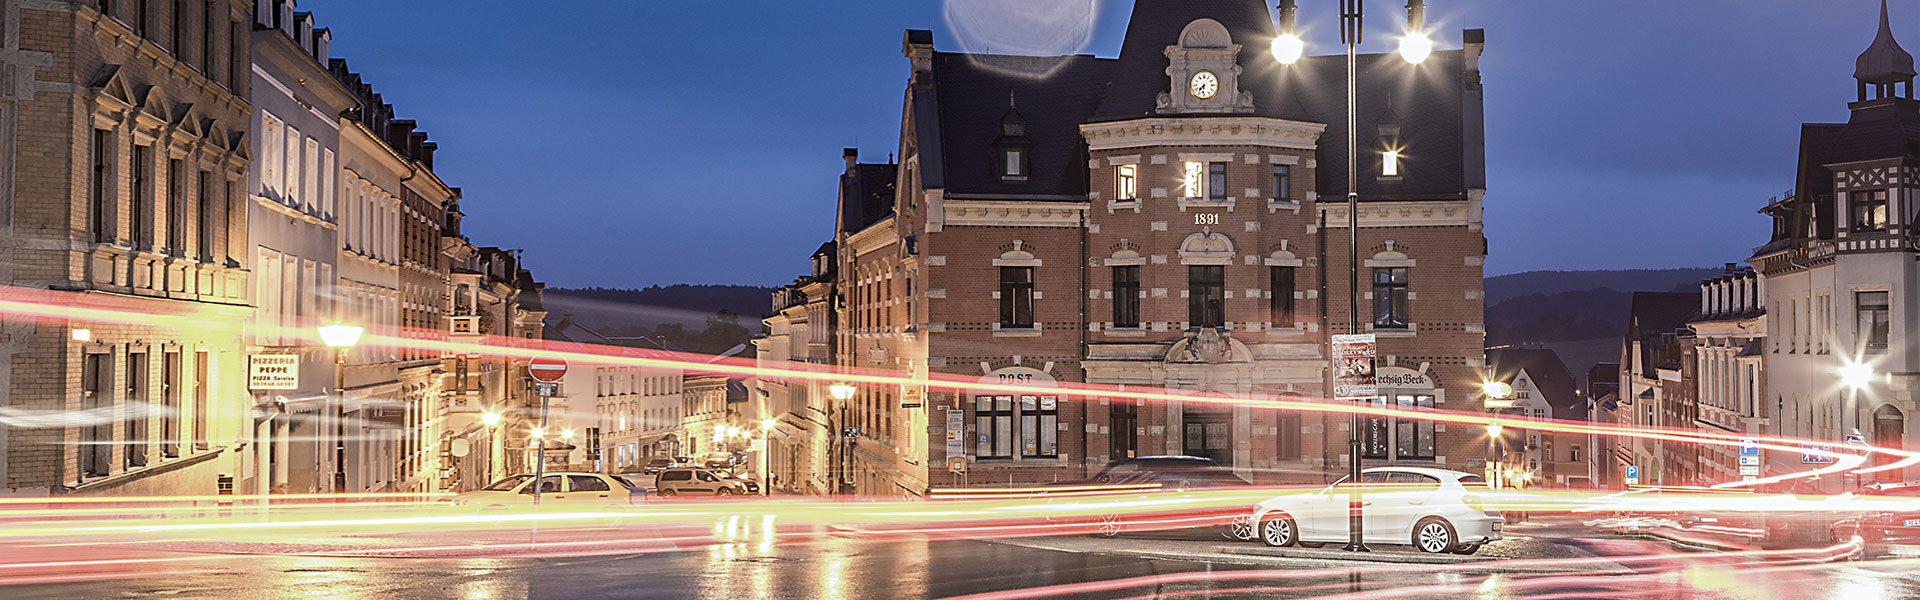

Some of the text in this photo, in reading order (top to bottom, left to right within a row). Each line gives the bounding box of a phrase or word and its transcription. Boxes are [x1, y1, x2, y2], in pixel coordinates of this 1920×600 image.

[1194, 213, 1219, 225] 1891
[998, 373, 1033, 384] POST
[1378, 374, 1402, 386] echsig
[1628, 467, 1635, 477] P
